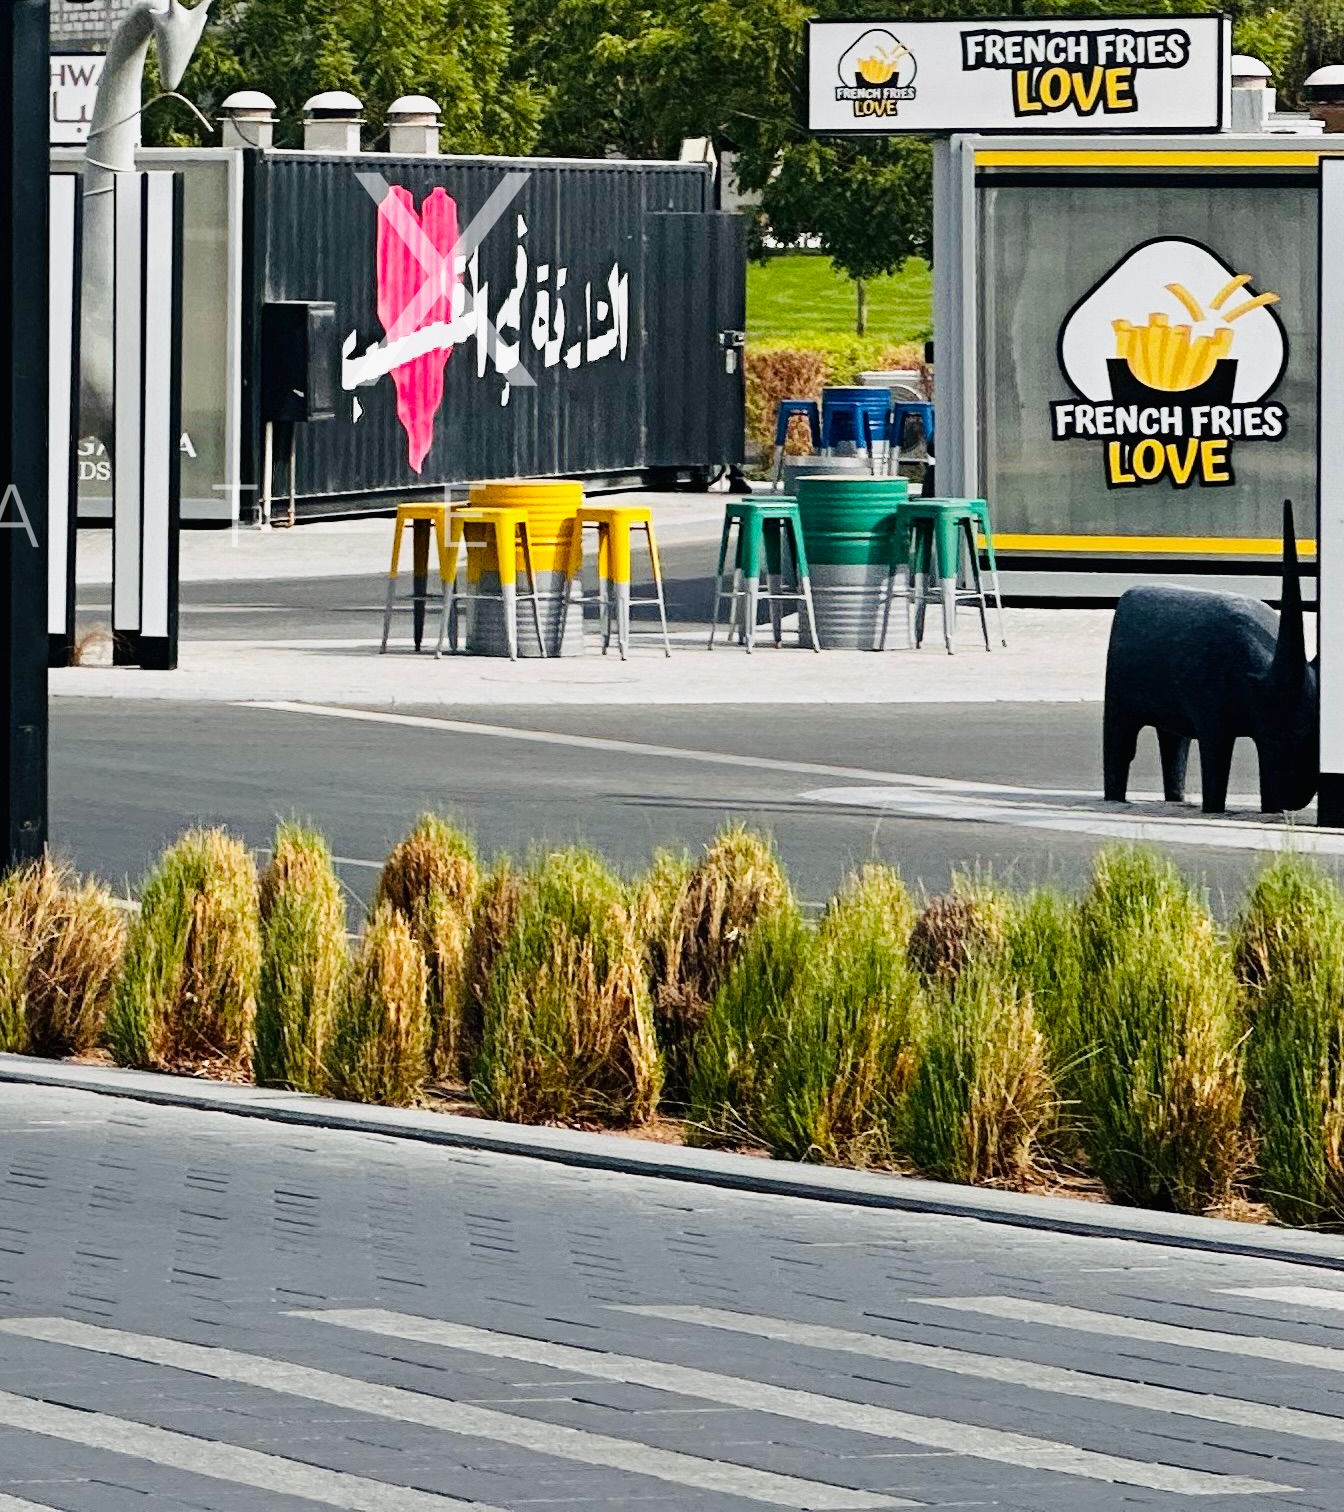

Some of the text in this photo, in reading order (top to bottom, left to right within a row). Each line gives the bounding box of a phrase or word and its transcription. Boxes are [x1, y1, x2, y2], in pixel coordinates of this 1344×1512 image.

[965, 33, 1186, 66] FRENCH FRIES
[836, 88, 915, 100] FRENCH FRIES
[1016, 65, 1133, 112] LOVE
[854, 100, 897, 117] LOVE
[1055, 404, 1284, 437] FRENCH FRIES
[1108, 437, 1230, 484] LOVE
